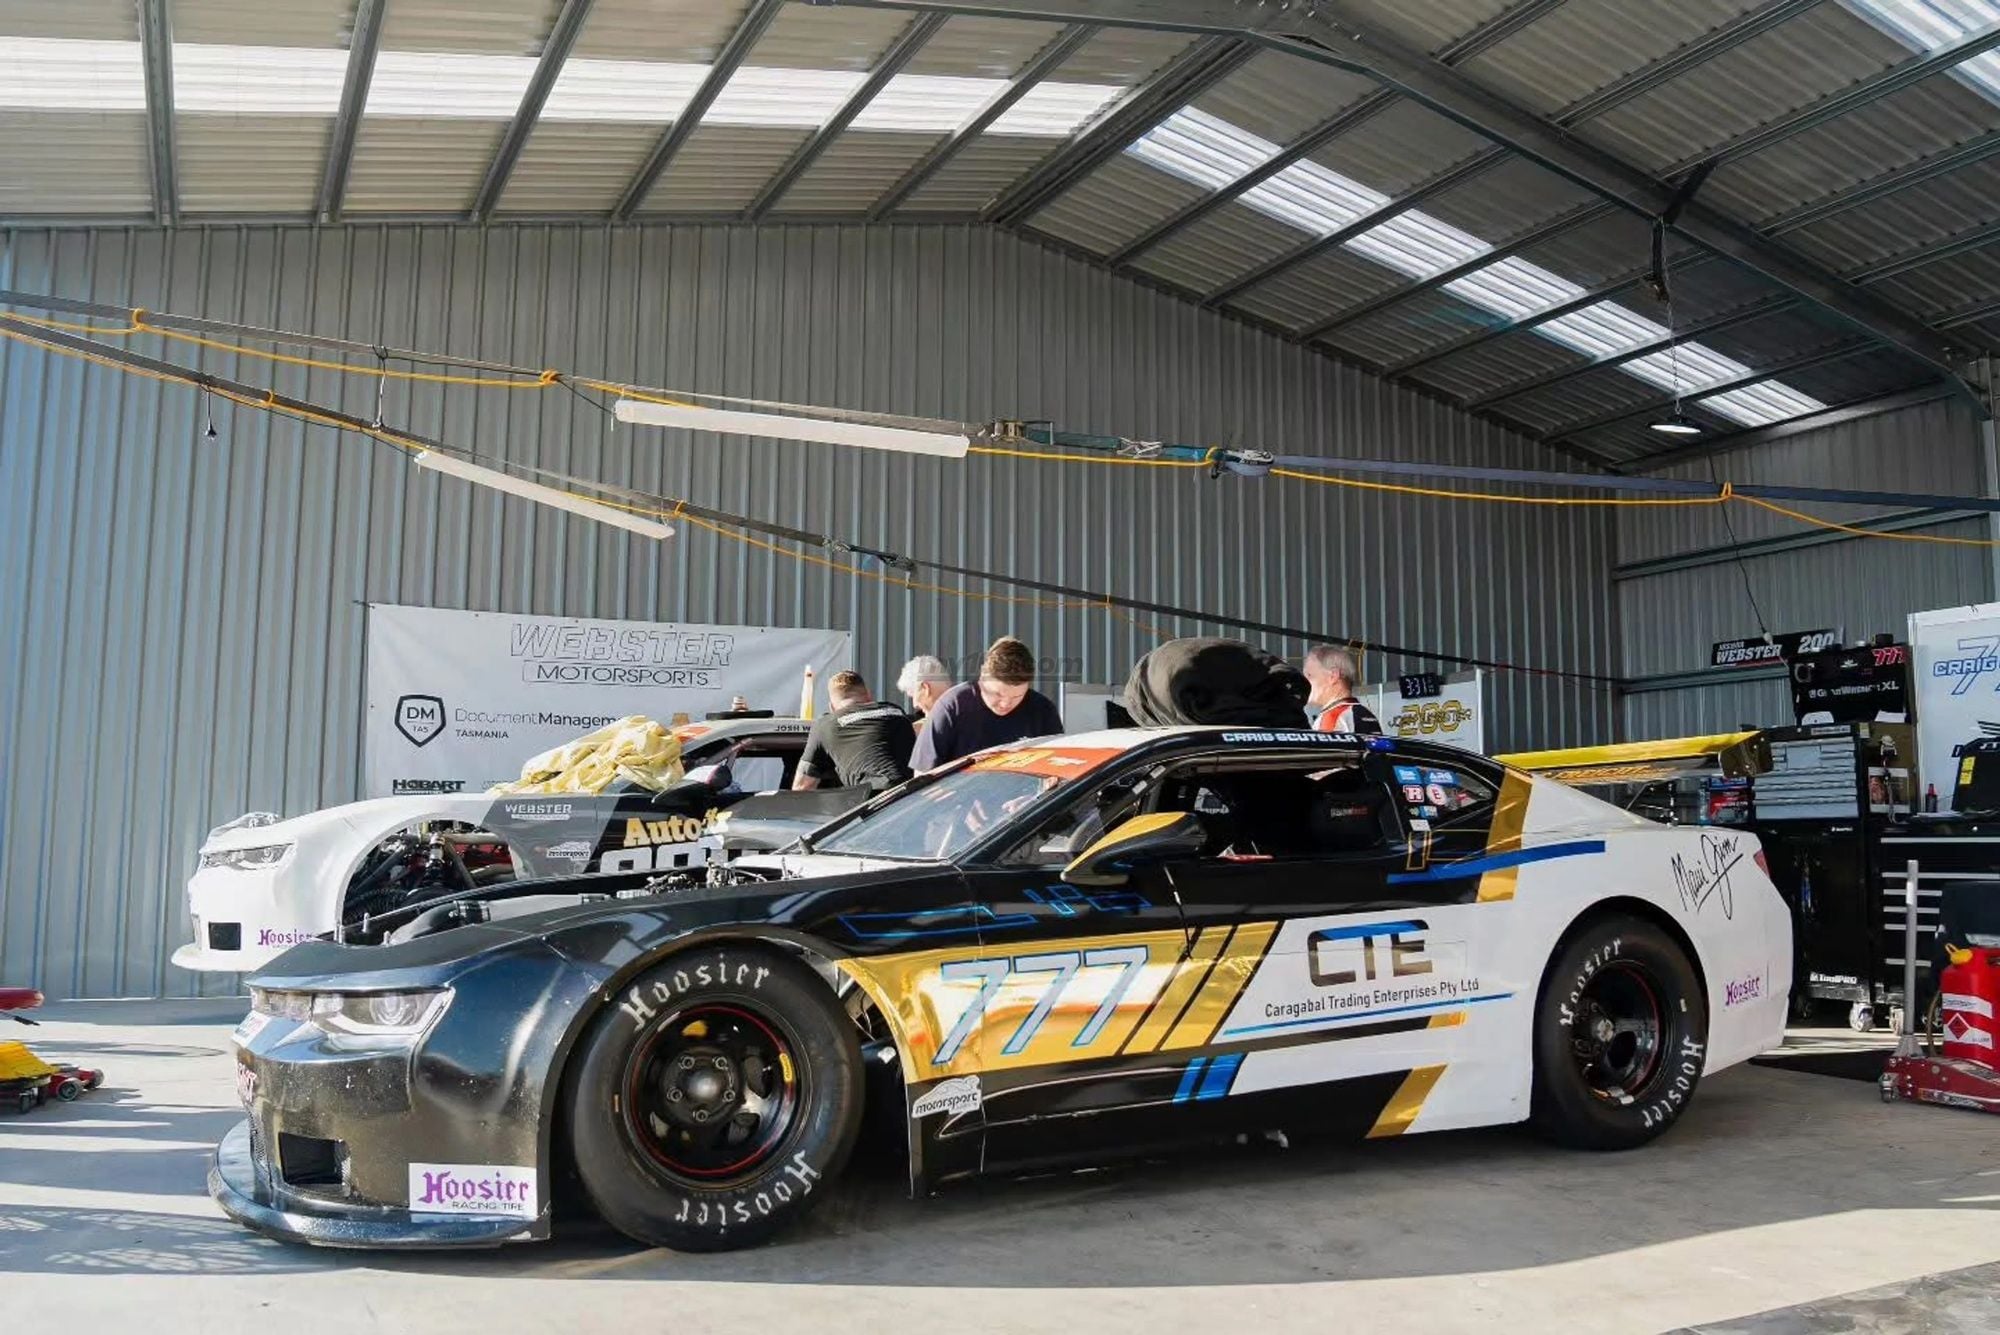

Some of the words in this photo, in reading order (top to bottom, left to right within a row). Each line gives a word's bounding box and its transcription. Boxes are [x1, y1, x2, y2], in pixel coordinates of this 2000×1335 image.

[511, 623, 735, 666] WEBSTER
[1716, 644, 1782, 663] WEBSTER
[536, 664, 709, 686] MOTORSPORTS
[1933, 656, 1999, 677] CRAIG
[406, 706, 435, 721] DM
[455, 708, 620, 729] DocumentManagem
[455, 729, 510, 739] TASMANIA
[1222, 733, 1274, 742] CRAIG
[1277, 733, 1358, 743] SCUTELLA
[393, 779, 466, 790] HOBART
[505, 804, 572, 814] WEBSTER
[1307, 919, 1433, 987] CTE
[619, 953, 771, 1033] Hoosier
[1559, 937, 1623, 1027] Hoosier
[1725, 975, 1760, 1006] Hoosier
[932, 944, 1149, 1065] 777
[1265, 999, 1325, 1018] Caragabal
[1329, 995, 1371, 1010] Trading
[1374, 984, 1437, 1004] Enterprises
[1440, 981, 1457, 996] Pty
[1460, 978, 1479, 992] Ltd
[1642, 1034, 1704, 1128] Hoosier
[916, 1092, 978, 1114] motorsport
[418, 1170, 529, 1204] Hoosier
[676, 1149, 823, 1234] Hoosier
[452, 1201, 497, 1210] RACING
[502, 1202, 525, 1211] TIRE
